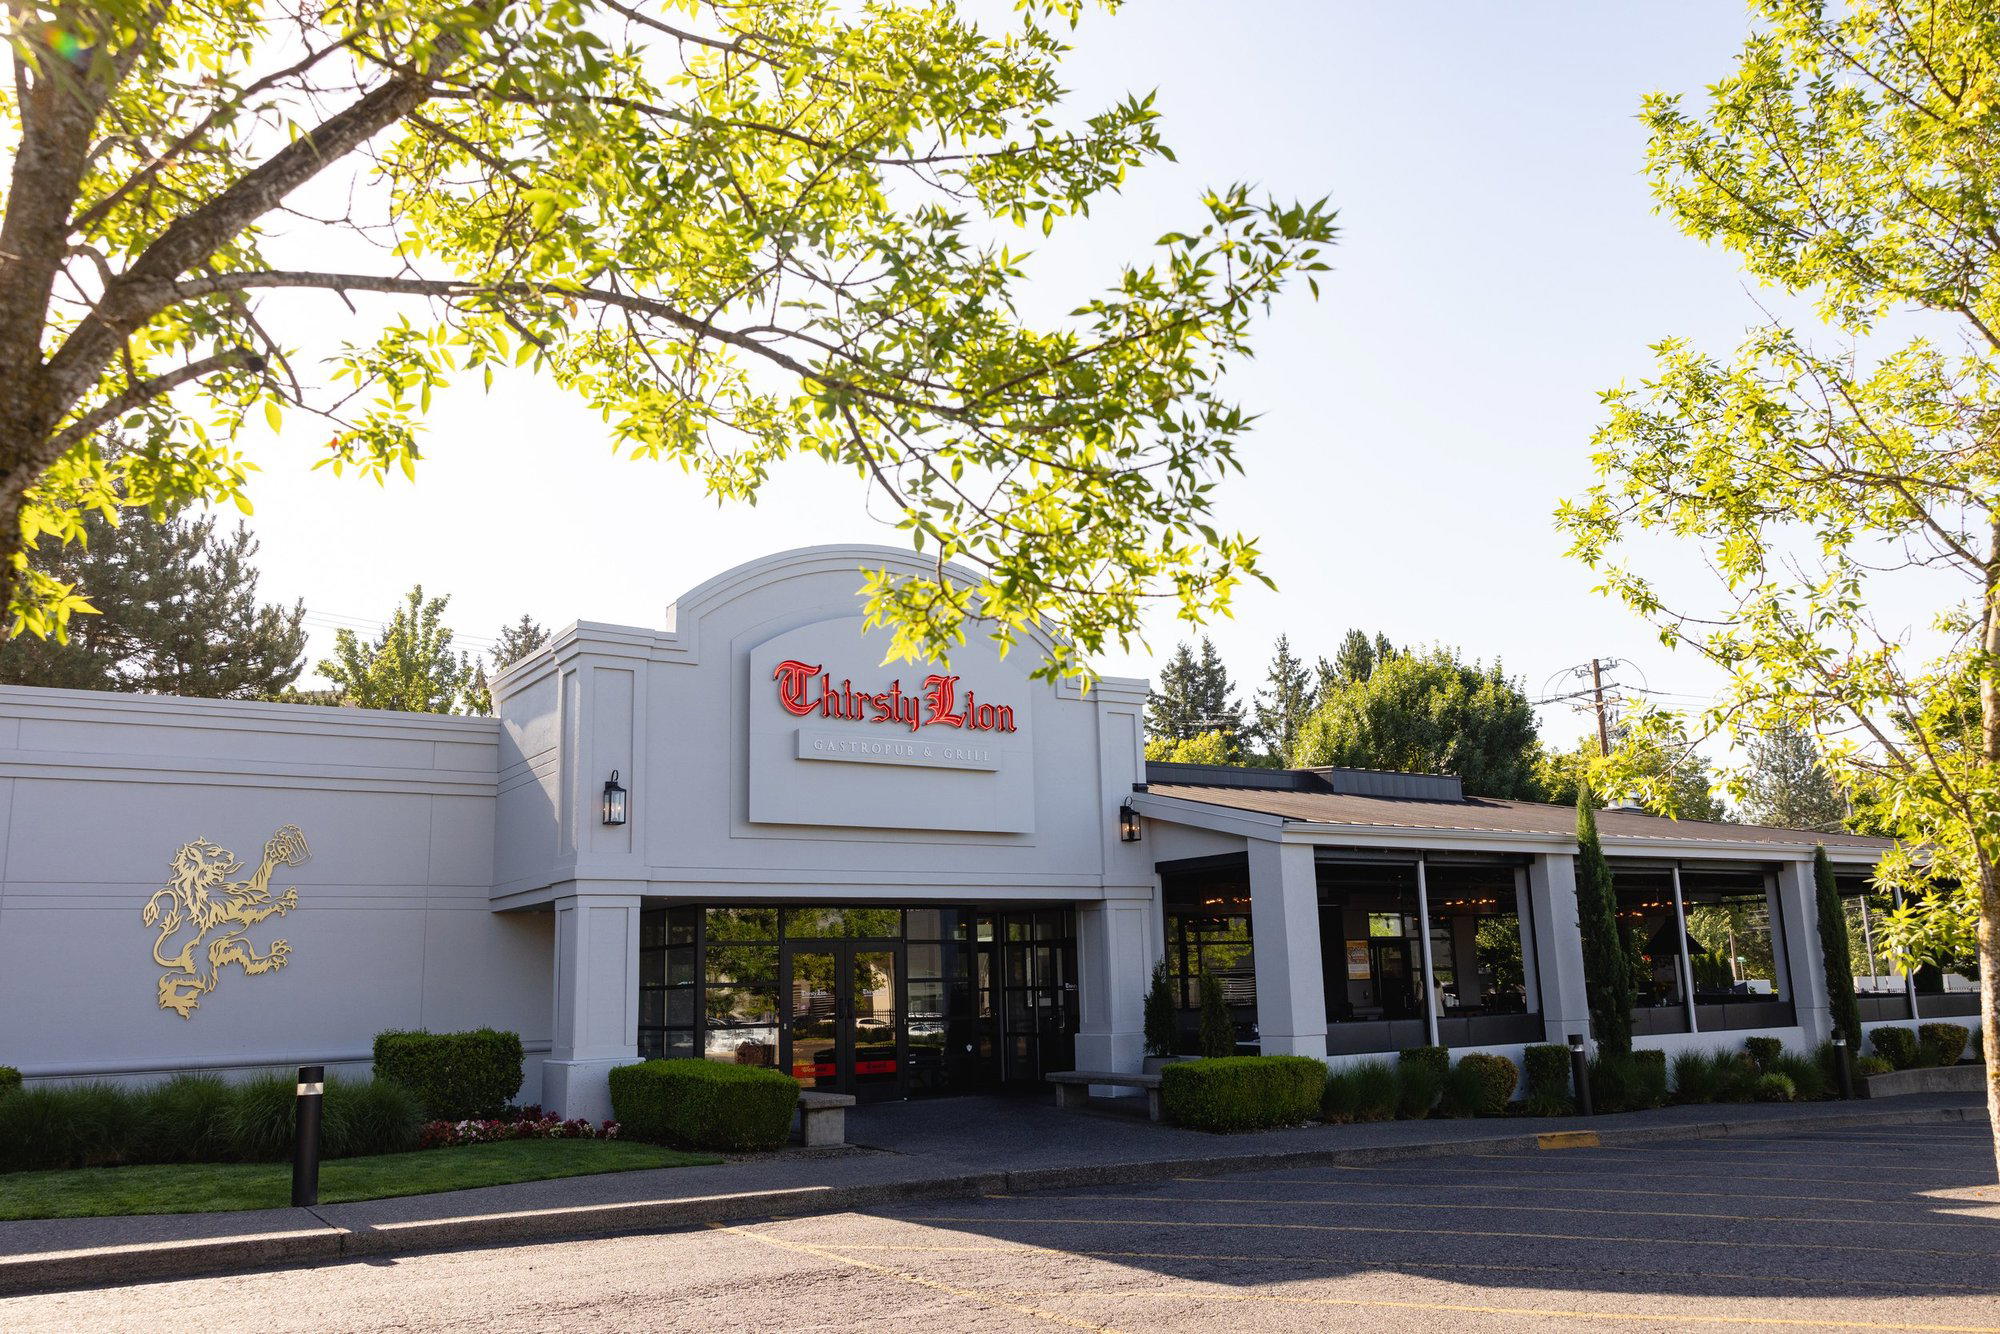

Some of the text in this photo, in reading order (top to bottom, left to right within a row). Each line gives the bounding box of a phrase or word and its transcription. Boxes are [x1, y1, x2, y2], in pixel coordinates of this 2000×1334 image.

[773, 659, 1018, 733] Thirsty Lion
[813, 738, 991, 761] GASTROPUB & GRILL
